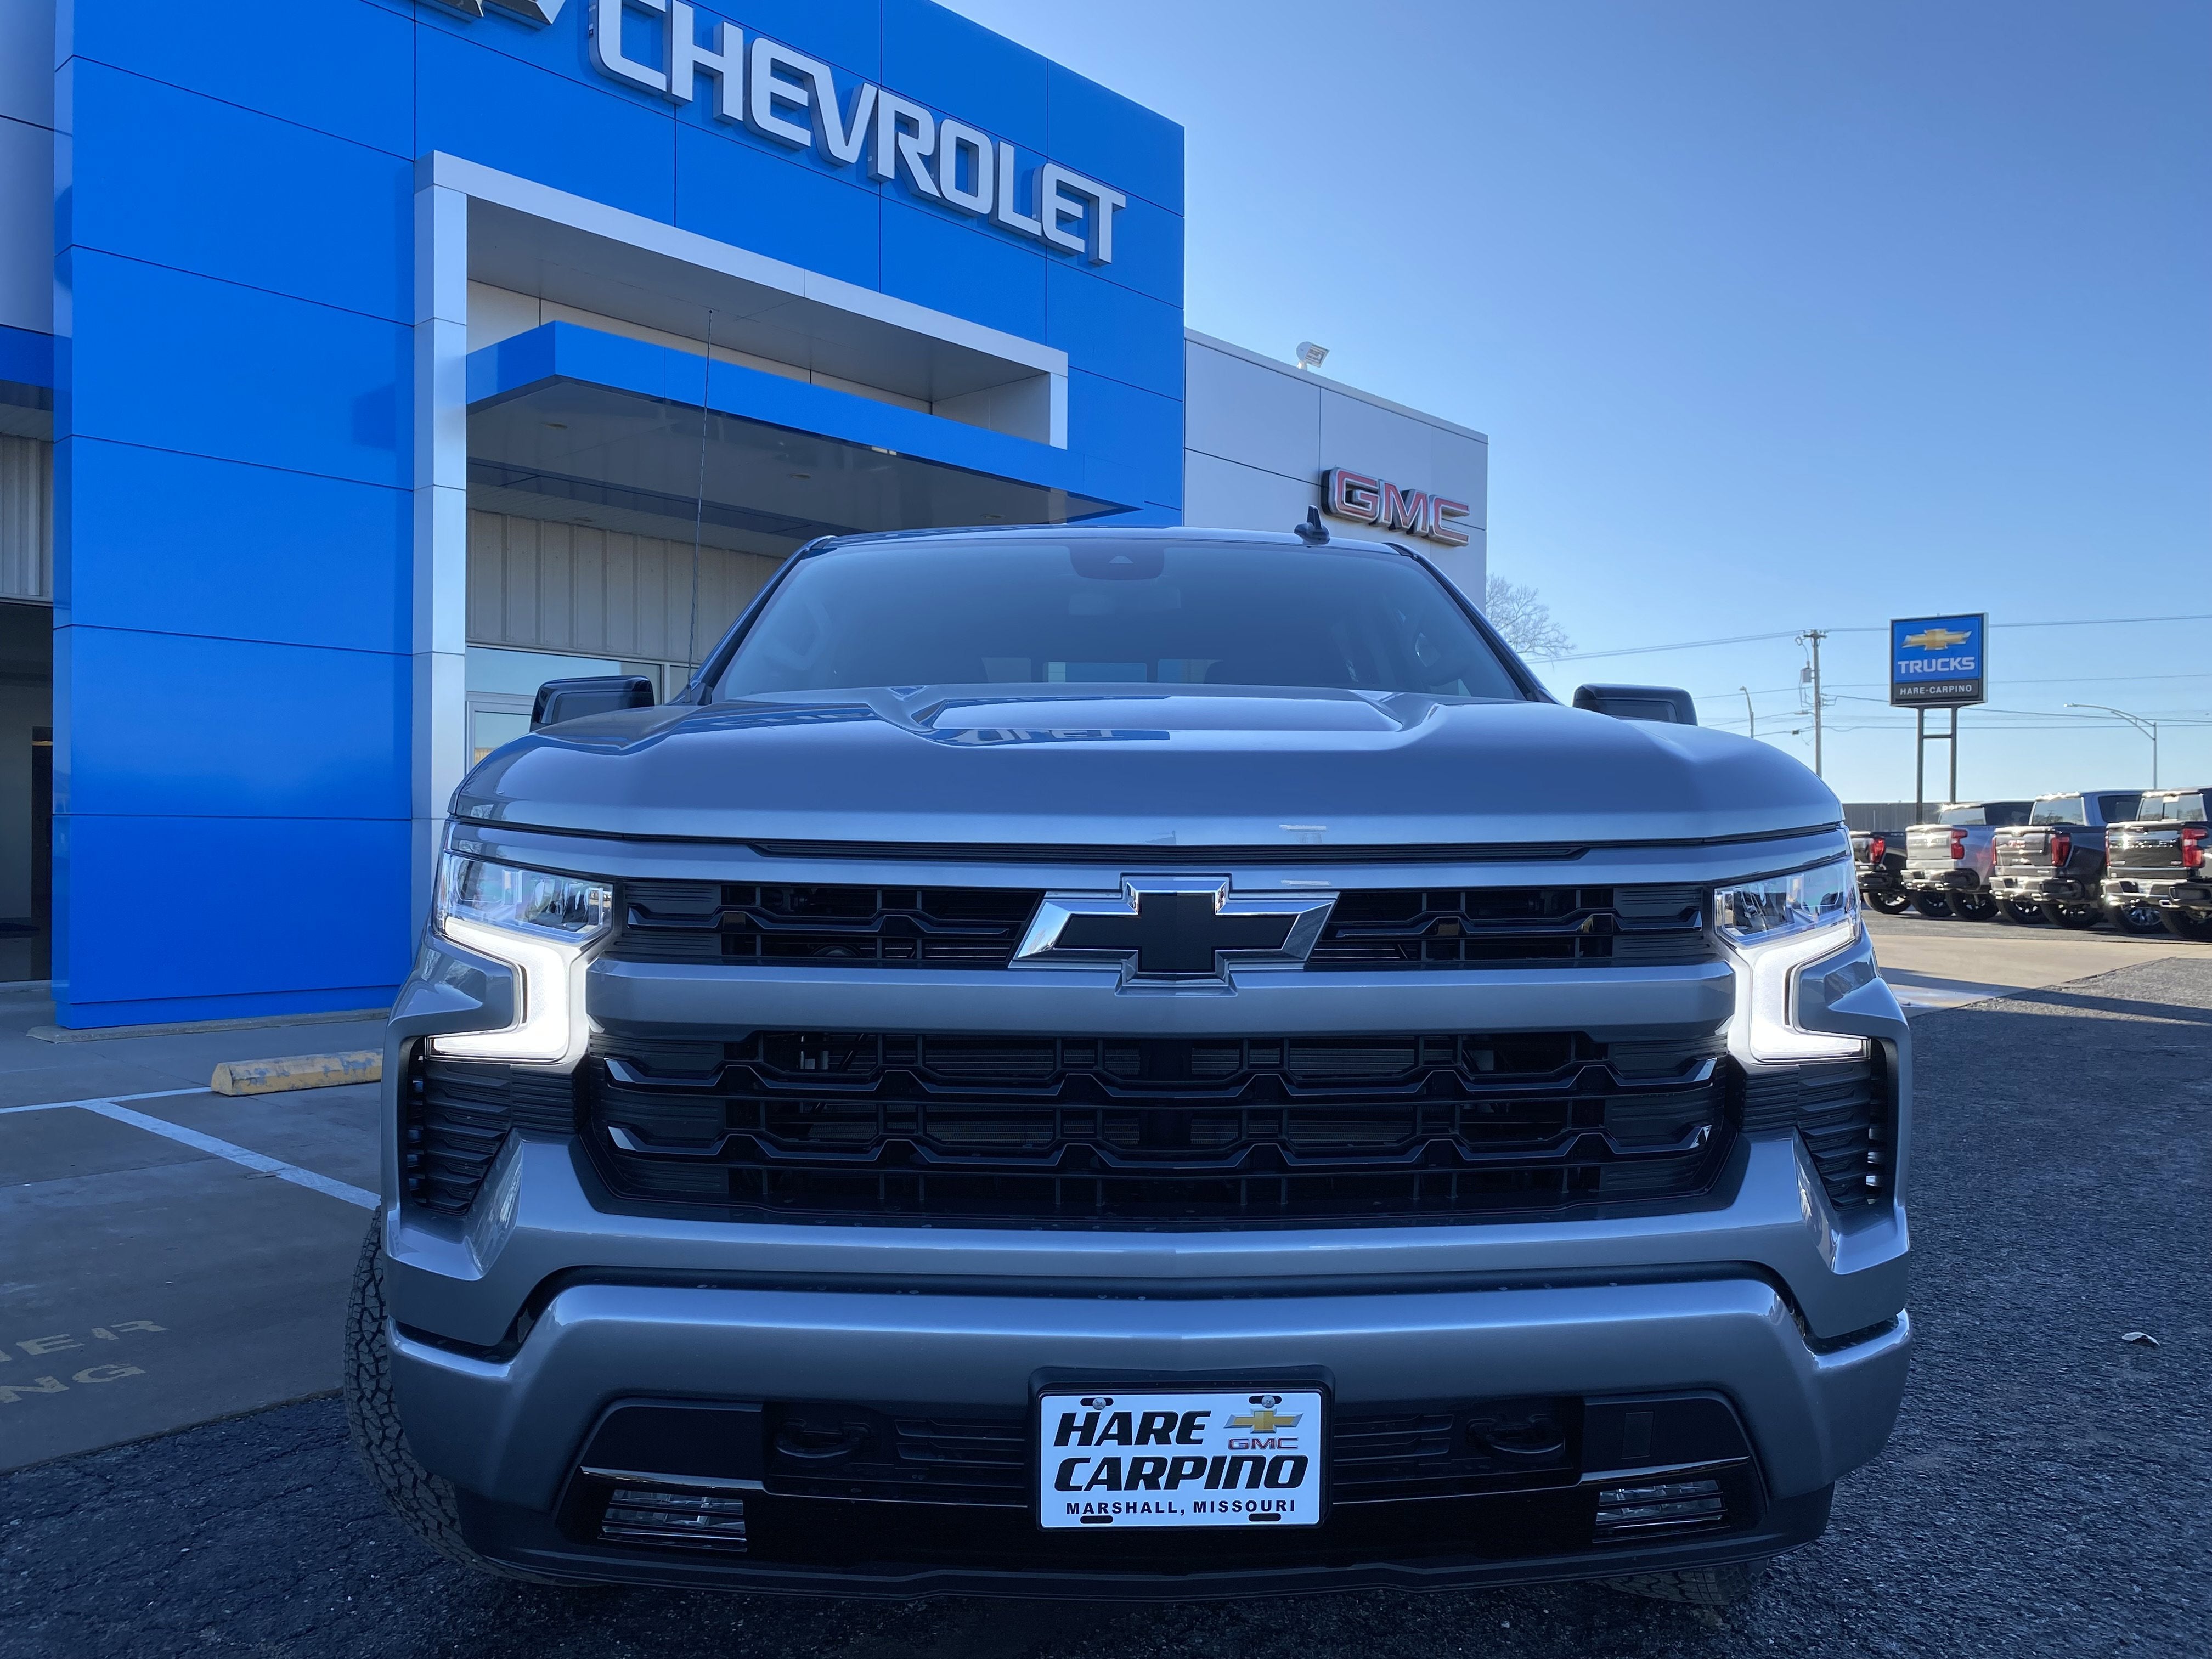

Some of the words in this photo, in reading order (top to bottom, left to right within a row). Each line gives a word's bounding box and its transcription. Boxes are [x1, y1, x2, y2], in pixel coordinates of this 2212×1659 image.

[590, 0, 1126, 266] CHEVROLET
[1321, 467, 1470, 547] GMC
[1898, 657, 1975, 674] TRUCKS
[1900, 685, 1972, 695] HARE-CARPINO
[1053, 1410, 1212, 1447] HARE
[1228, 1437, 1299, 1450] GMC
[1054, 1455, 1308, 1491] CARPINO
[1066, 1502, 1185, 1516] MARSHALL,
[1193, 1499, 1295, 1513] MISSOURI
